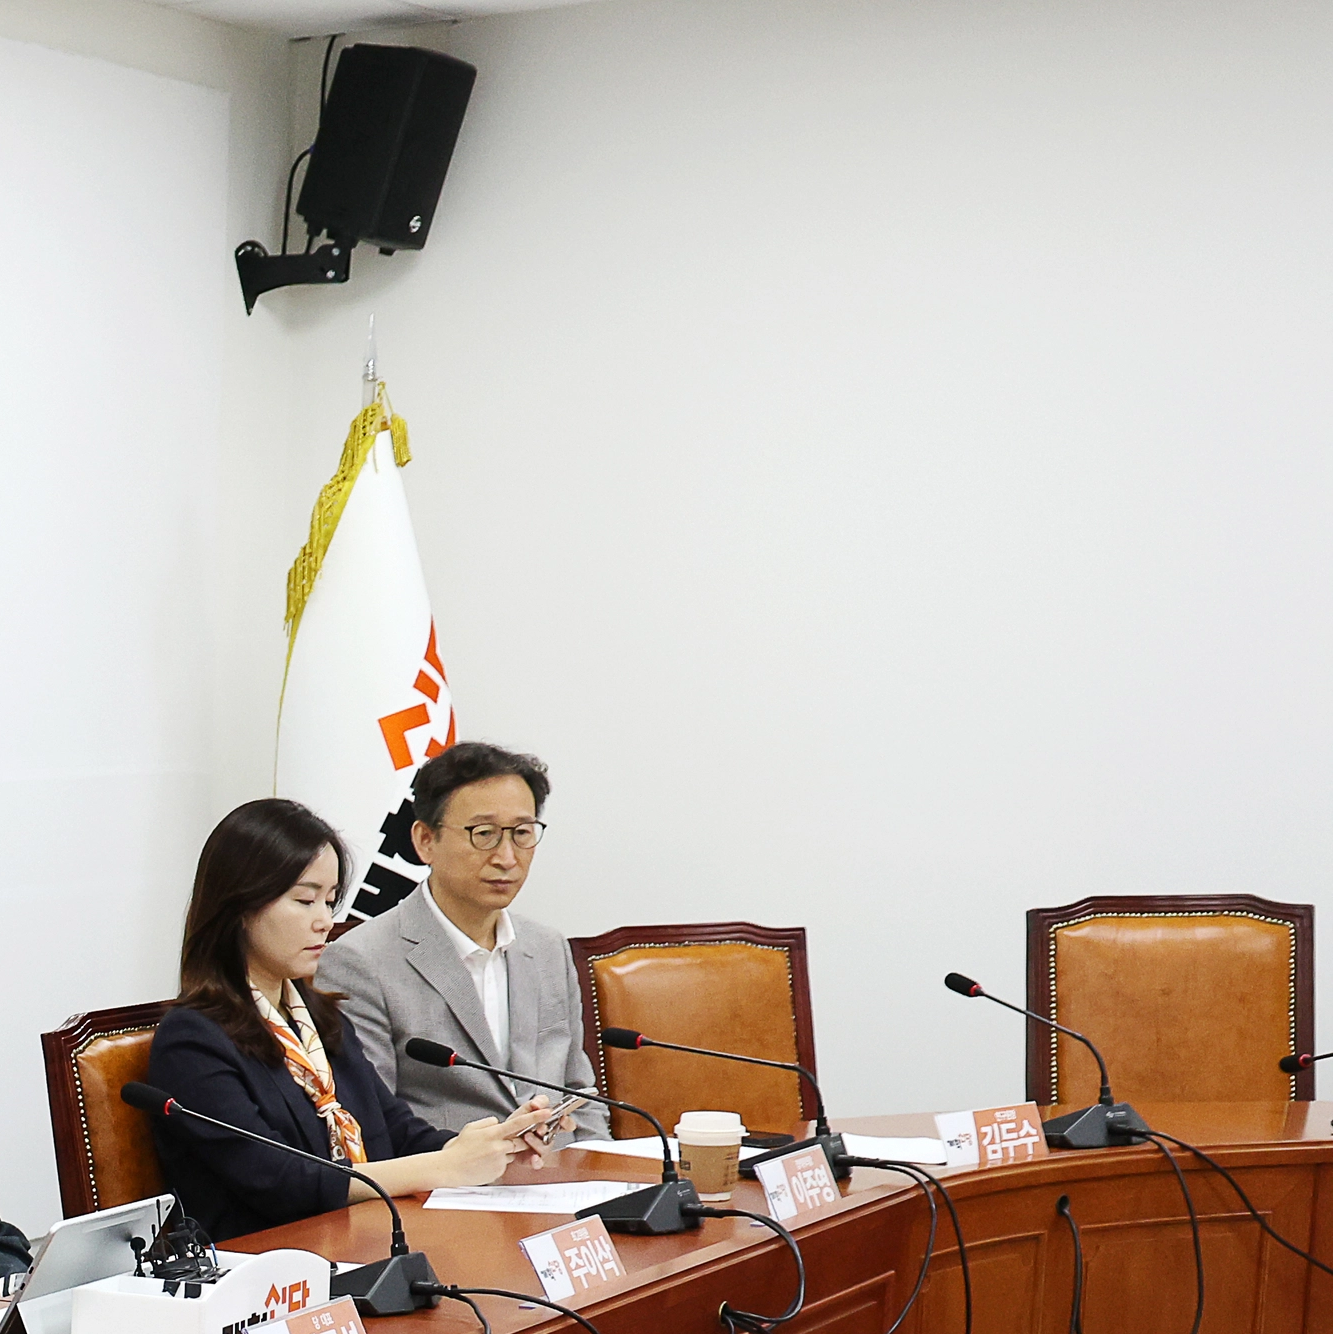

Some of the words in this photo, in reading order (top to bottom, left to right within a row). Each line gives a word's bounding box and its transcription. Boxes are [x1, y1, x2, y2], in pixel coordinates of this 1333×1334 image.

[980, 1119, 1040, 1161] 김두수
[791, 1164, 835, 1210] 이주영
[564, 1235, 620, 1290] 주이삭
